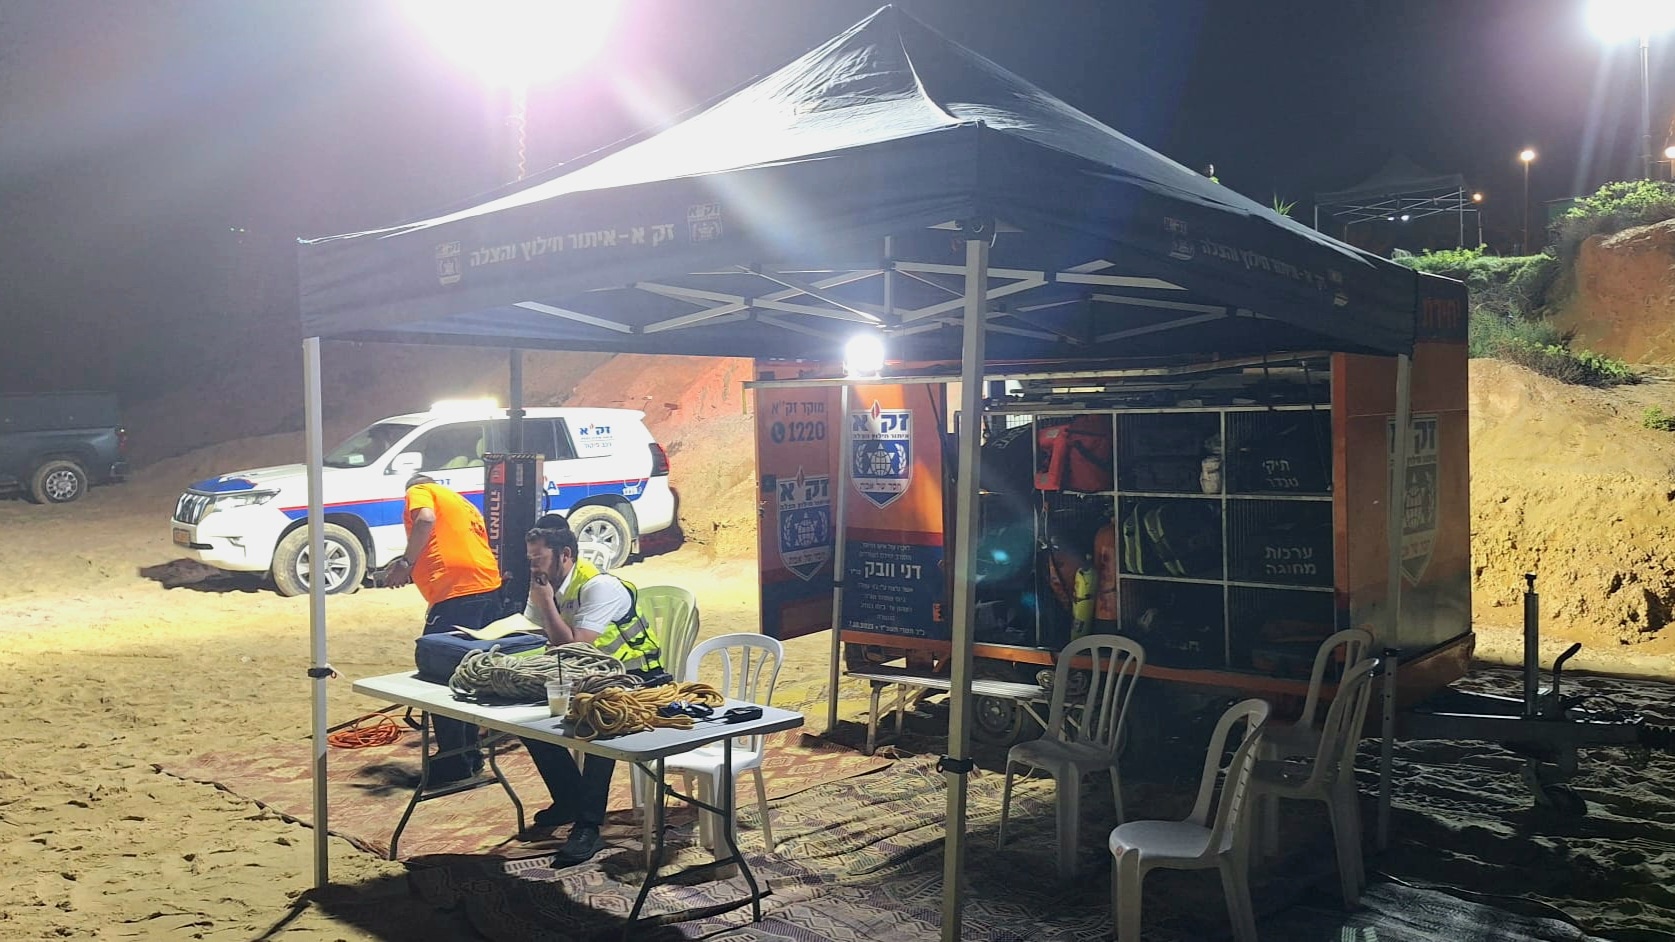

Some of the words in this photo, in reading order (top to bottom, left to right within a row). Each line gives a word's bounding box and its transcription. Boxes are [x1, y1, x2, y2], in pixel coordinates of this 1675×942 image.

[469, 243, 517, 268] והצלה
[520, 235, 564, 262] חילוץ
[800, 401, 824, 416] מוקד
[789, 421, 825, 442] 1220
[1264, 547, 1313, 560] ערכות
[864, 561, 895, 579] וובק
[900, 564, 921, 579] דני
[1265, 563, 1316, 575] מחוגה
